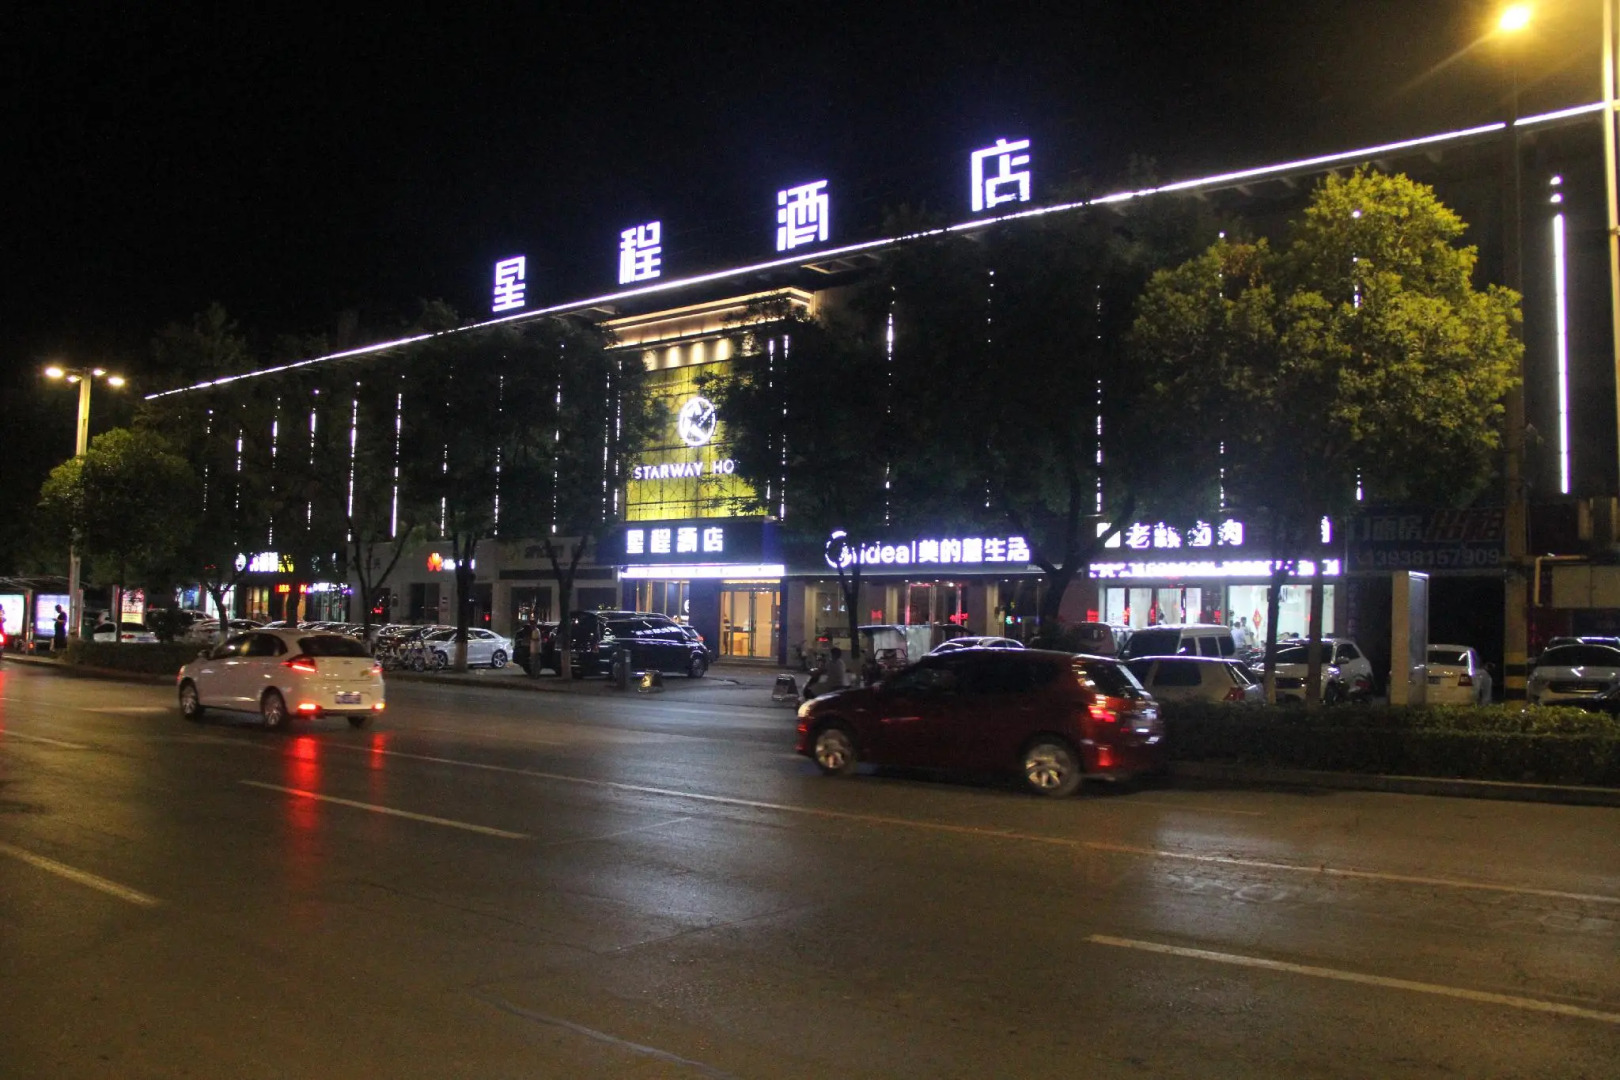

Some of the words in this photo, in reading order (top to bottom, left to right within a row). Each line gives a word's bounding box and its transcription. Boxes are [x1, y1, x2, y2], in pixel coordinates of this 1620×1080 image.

[492, 139, 1030, 312] 星程酒店
[634, 461, 703, 480] STARWAY
[713, 459, 739, 475] HO
[626, 526, 724, 554] 星程酒店
